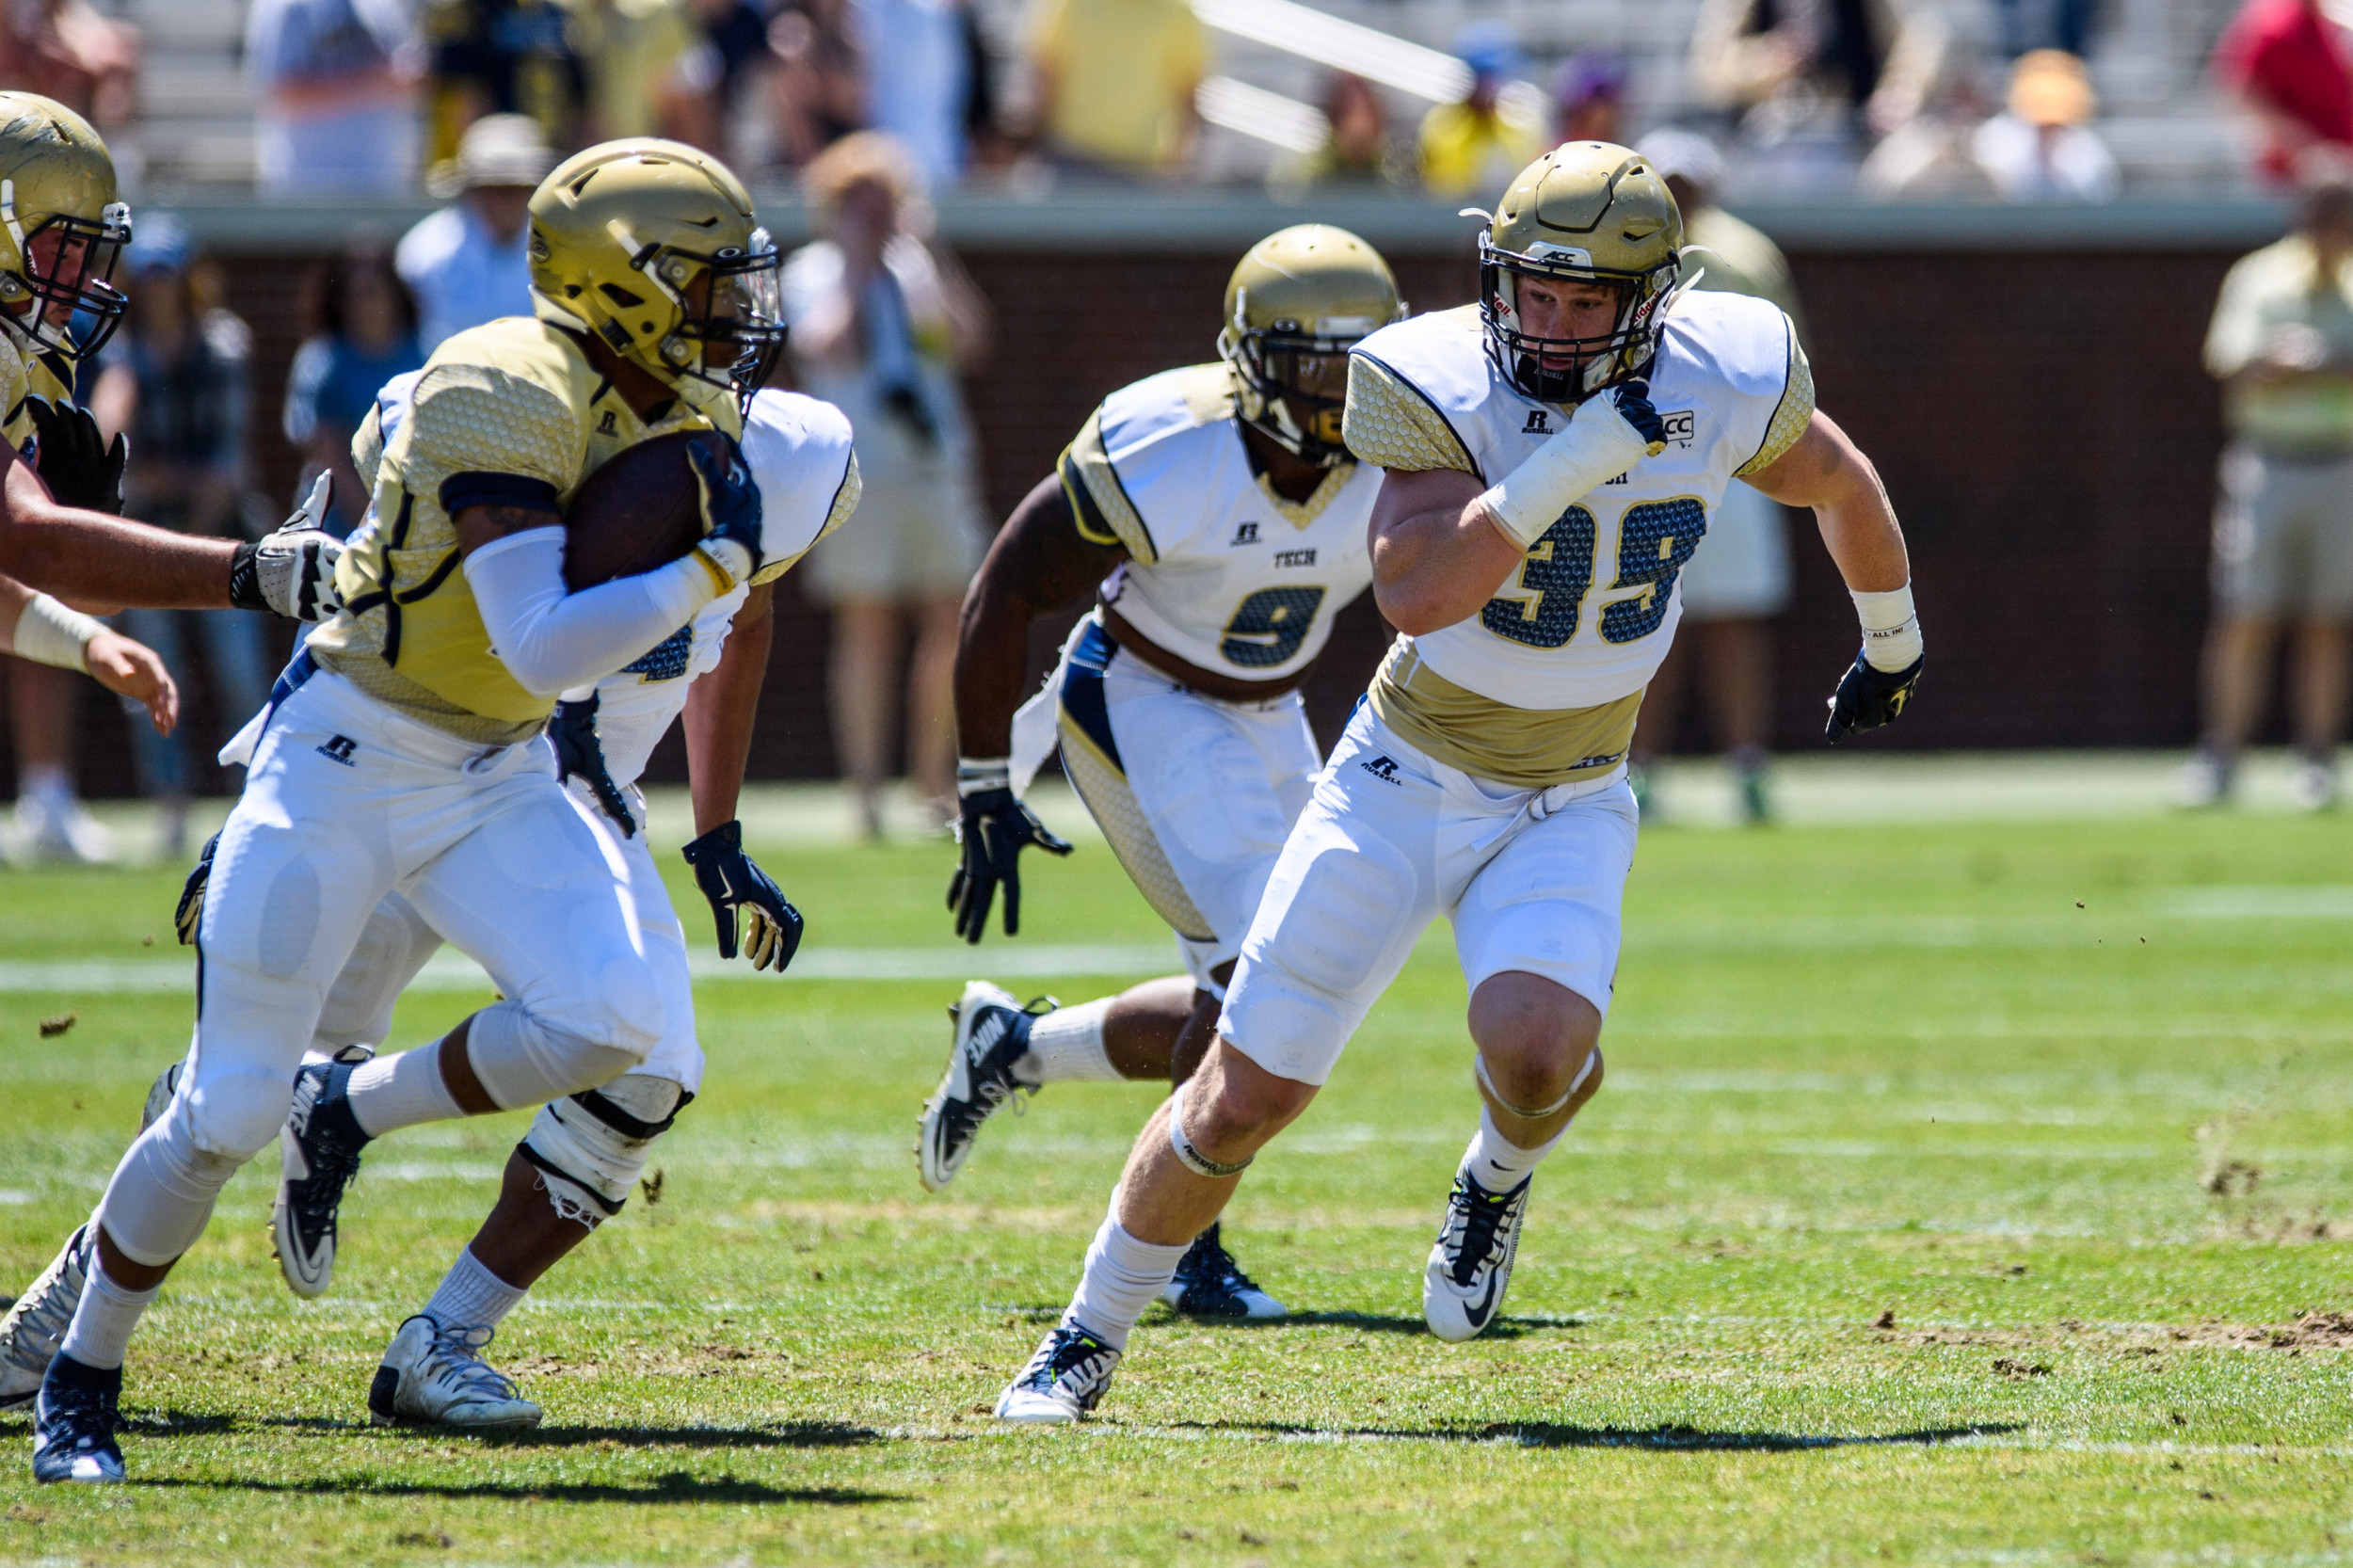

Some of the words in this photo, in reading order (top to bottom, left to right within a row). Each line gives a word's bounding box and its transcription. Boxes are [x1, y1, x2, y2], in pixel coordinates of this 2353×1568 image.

[1543, 250, 1576, 264] ACC
[1527, 410, 1548, 428] R
[1663, 417, 1692, 436] CC
[1521, 426, 1554, 435] RUSSELL
[1274, 548, 1317, 568] TECH
[1478, 494, 1708, 651] 39
[1218, 584, 1329, 669] 9
[1892, 627, 1904, 636] IN!
[314, 745, 356, 767] RUSSELL
[1360, 761, 1402, 786] RUSSELL
[963, 1012, 1005, 1068] NIKE
[286, 1070, 322, 1138] NIKE
